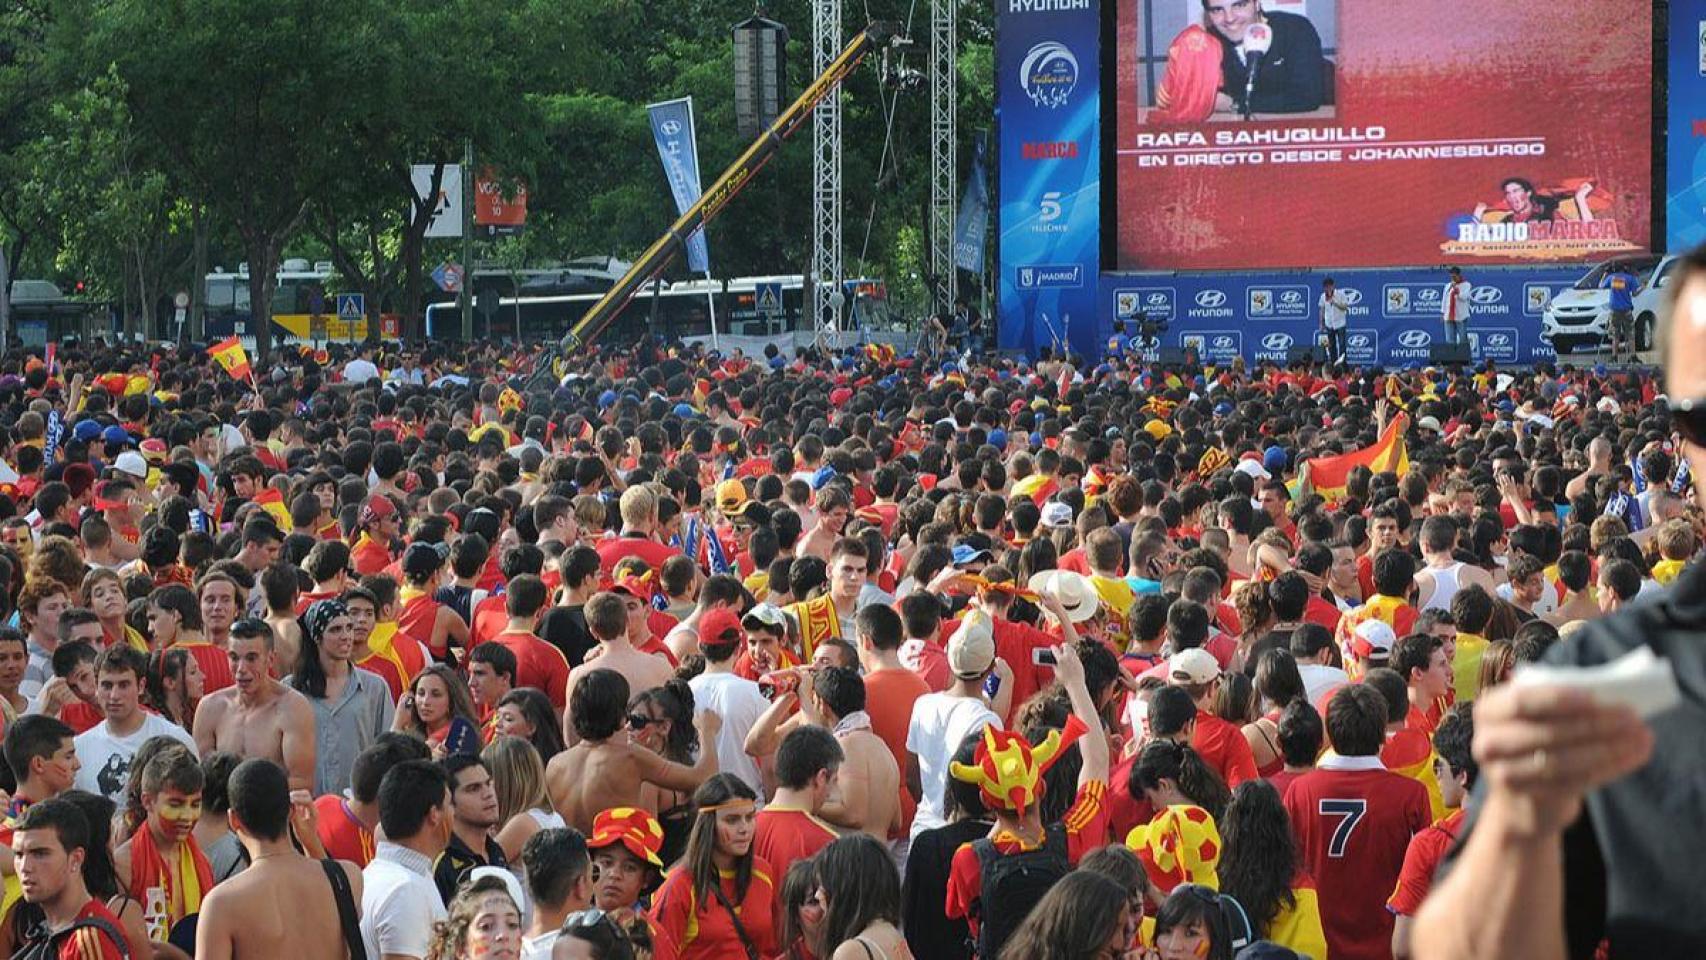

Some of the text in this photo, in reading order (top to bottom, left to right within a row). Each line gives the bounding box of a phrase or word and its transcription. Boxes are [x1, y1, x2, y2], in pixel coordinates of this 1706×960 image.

[1137, 126, 1386, 147] RAFA SAHUQUILLO
[1021, 141, 1078, 160] MARCA
[1138, 143, 1546, 167] EN DIRECTO DESDE JOHANNESBURGO
[1188, 308, 1233, 318] HYUNDAI
[1469, 305, 1510, 314] YUNDAI
[1319, 799, 1367, 857] 7
